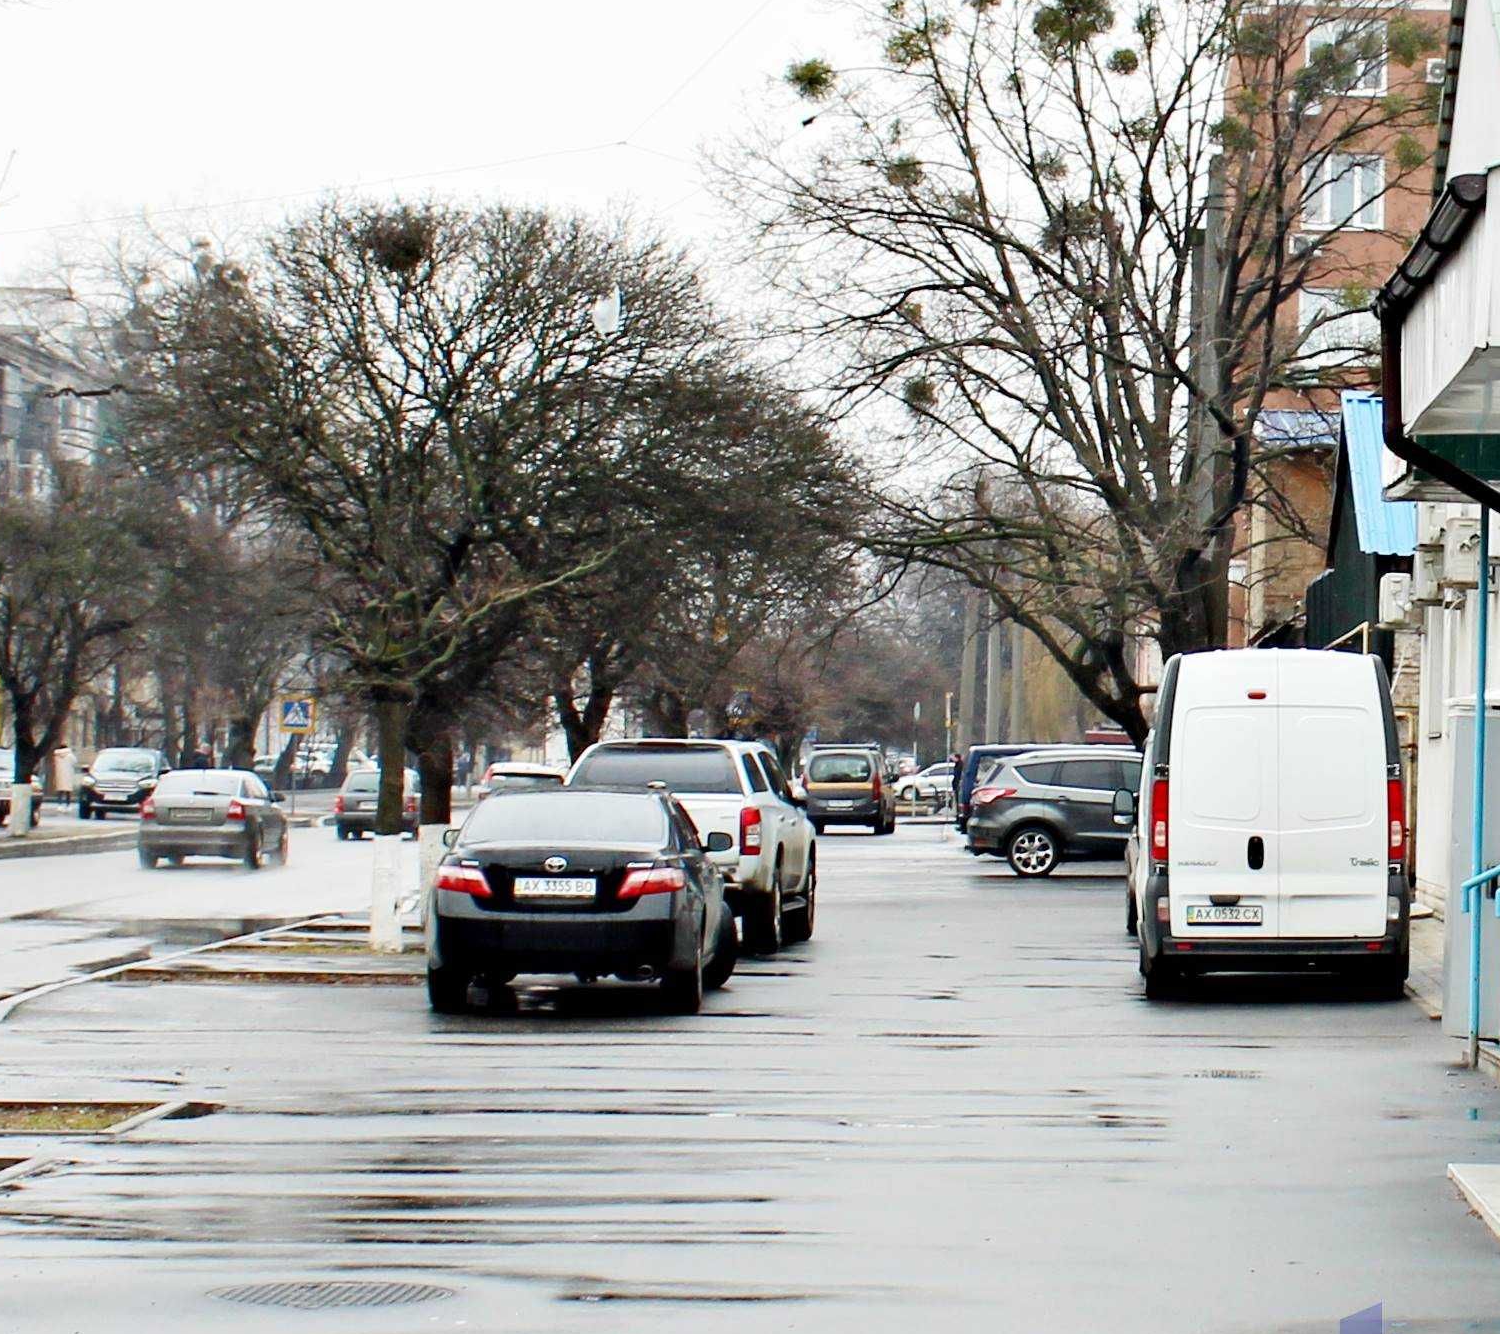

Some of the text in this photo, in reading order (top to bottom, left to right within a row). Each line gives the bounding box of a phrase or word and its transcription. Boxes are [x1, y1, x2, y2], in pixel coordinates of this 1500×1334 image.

[544, 880, 573, 893] 3355
[1195, 907, 1260, 920] AX 0532 CX
